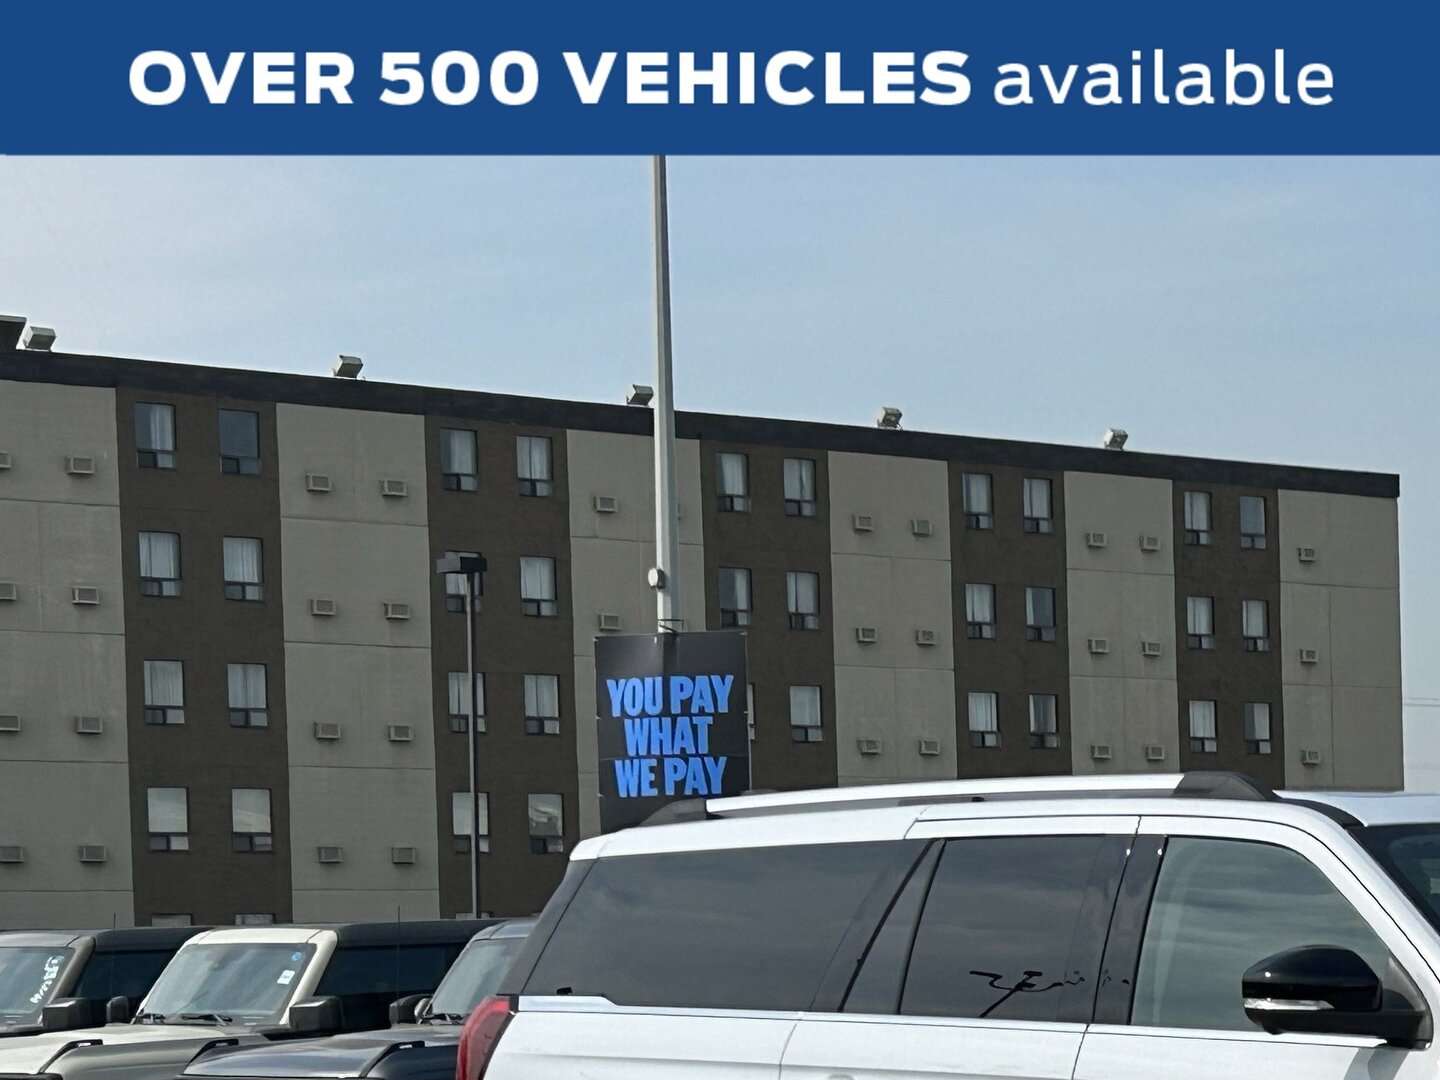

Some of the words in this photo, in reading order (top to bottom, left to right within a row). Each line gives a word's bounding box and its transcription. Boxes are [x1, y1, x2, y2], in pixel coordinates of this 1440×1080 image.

[606, 676, 663, 717] YOU
[669, 675, 734, 714] PAY
[624, 716, 713, 756] WHAT
[614, 758, 658, 798] WE
[664, 756, 727, 796] PAY
